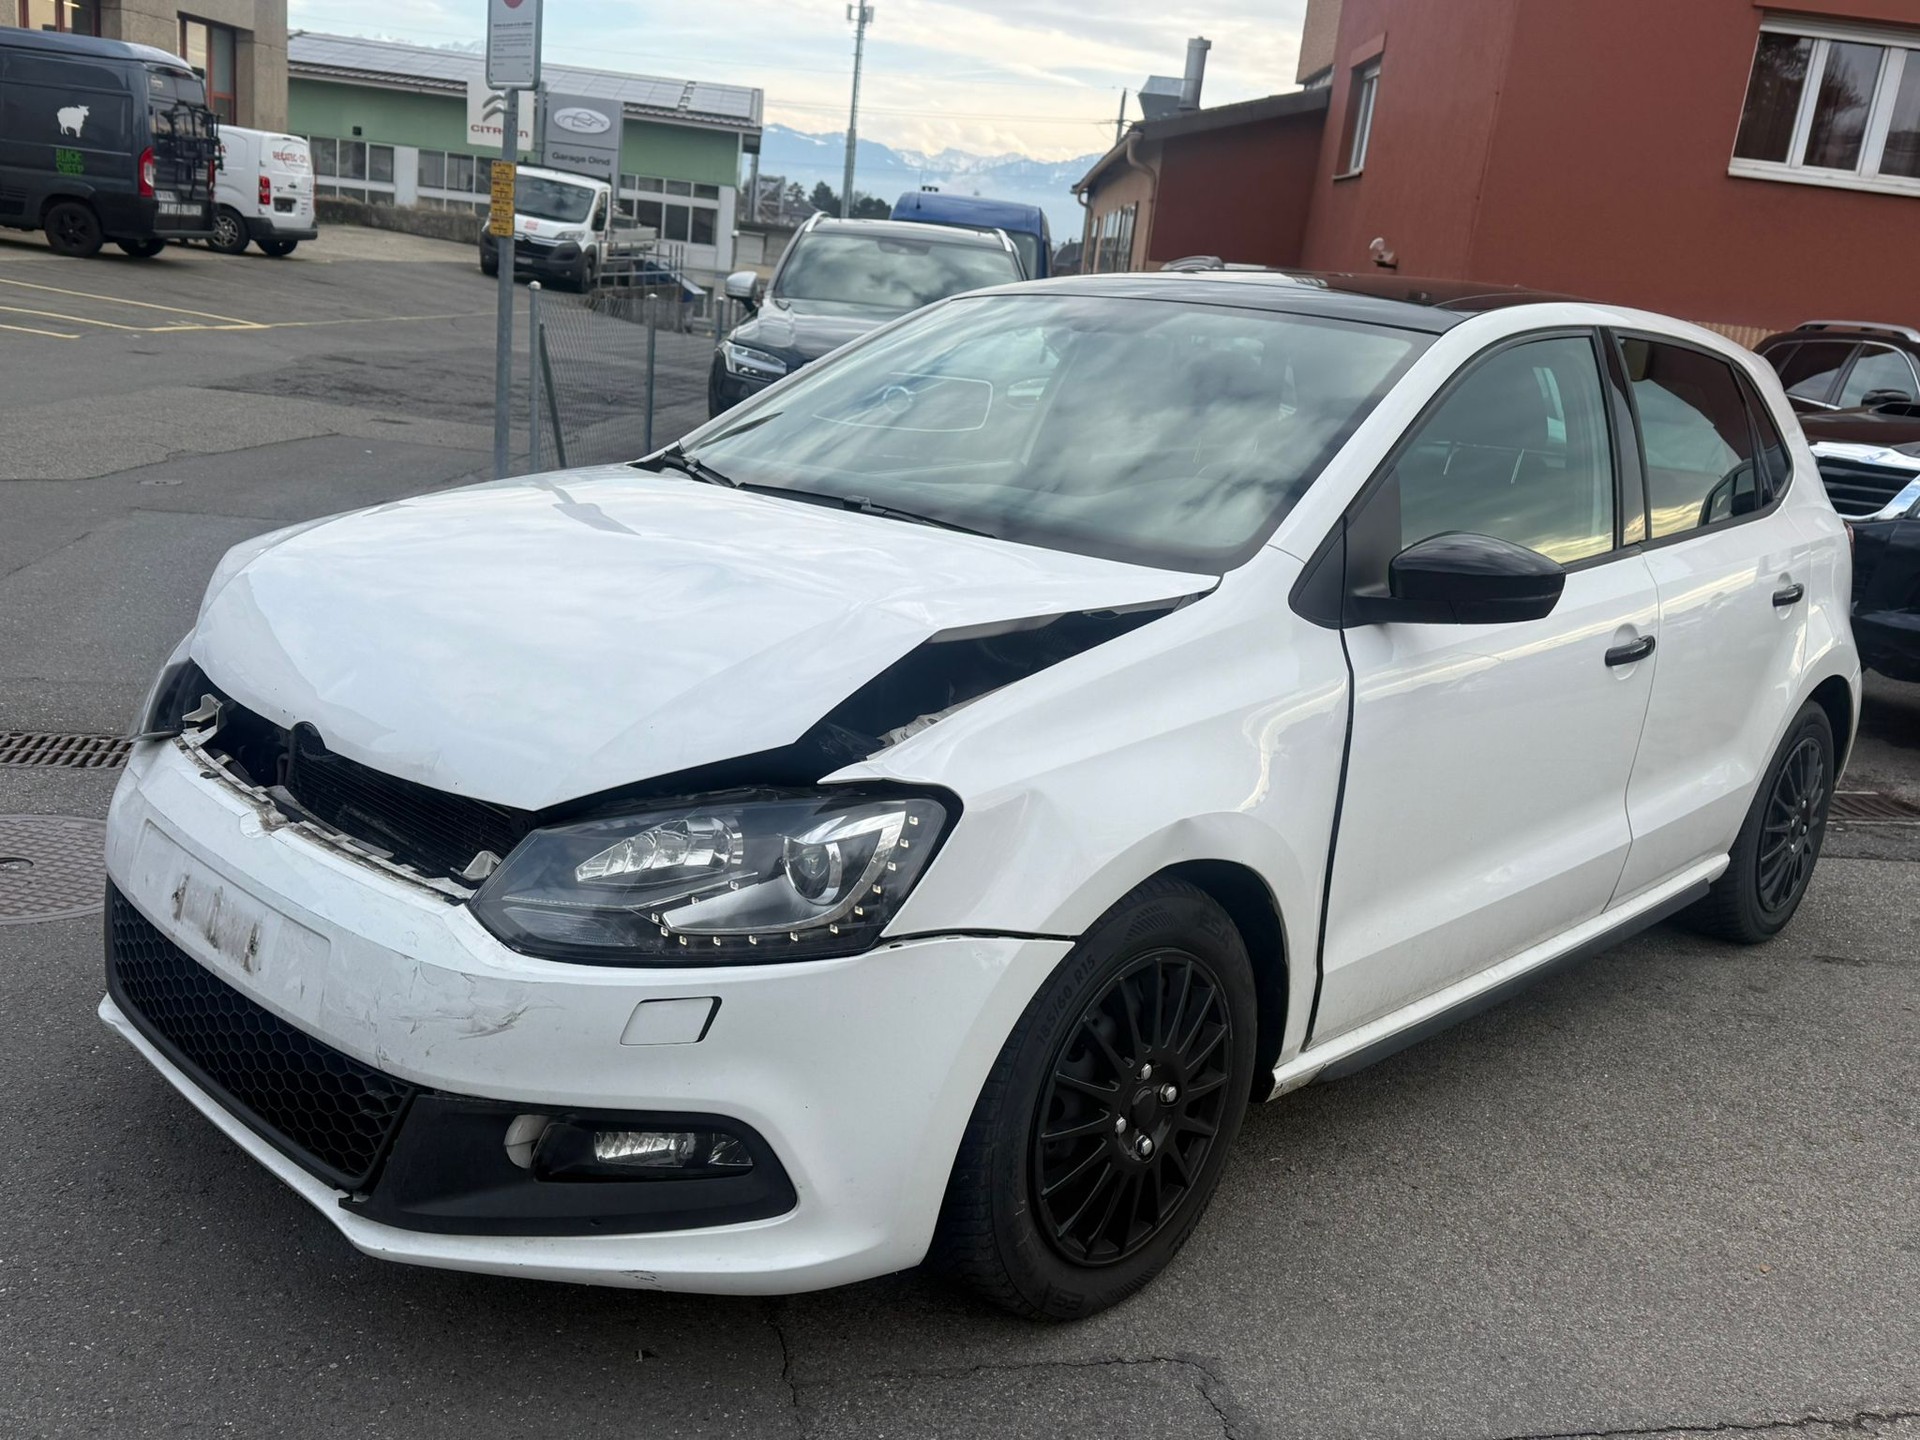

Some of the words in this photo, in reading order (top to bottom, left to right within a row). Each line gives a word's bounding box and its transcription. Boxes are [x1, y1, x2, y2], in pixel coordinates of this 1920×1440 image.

[470, 124, 529, 138] CITRN
[551, 151, 586, 164] Garage
[588, 156, 611, 167] Dind
